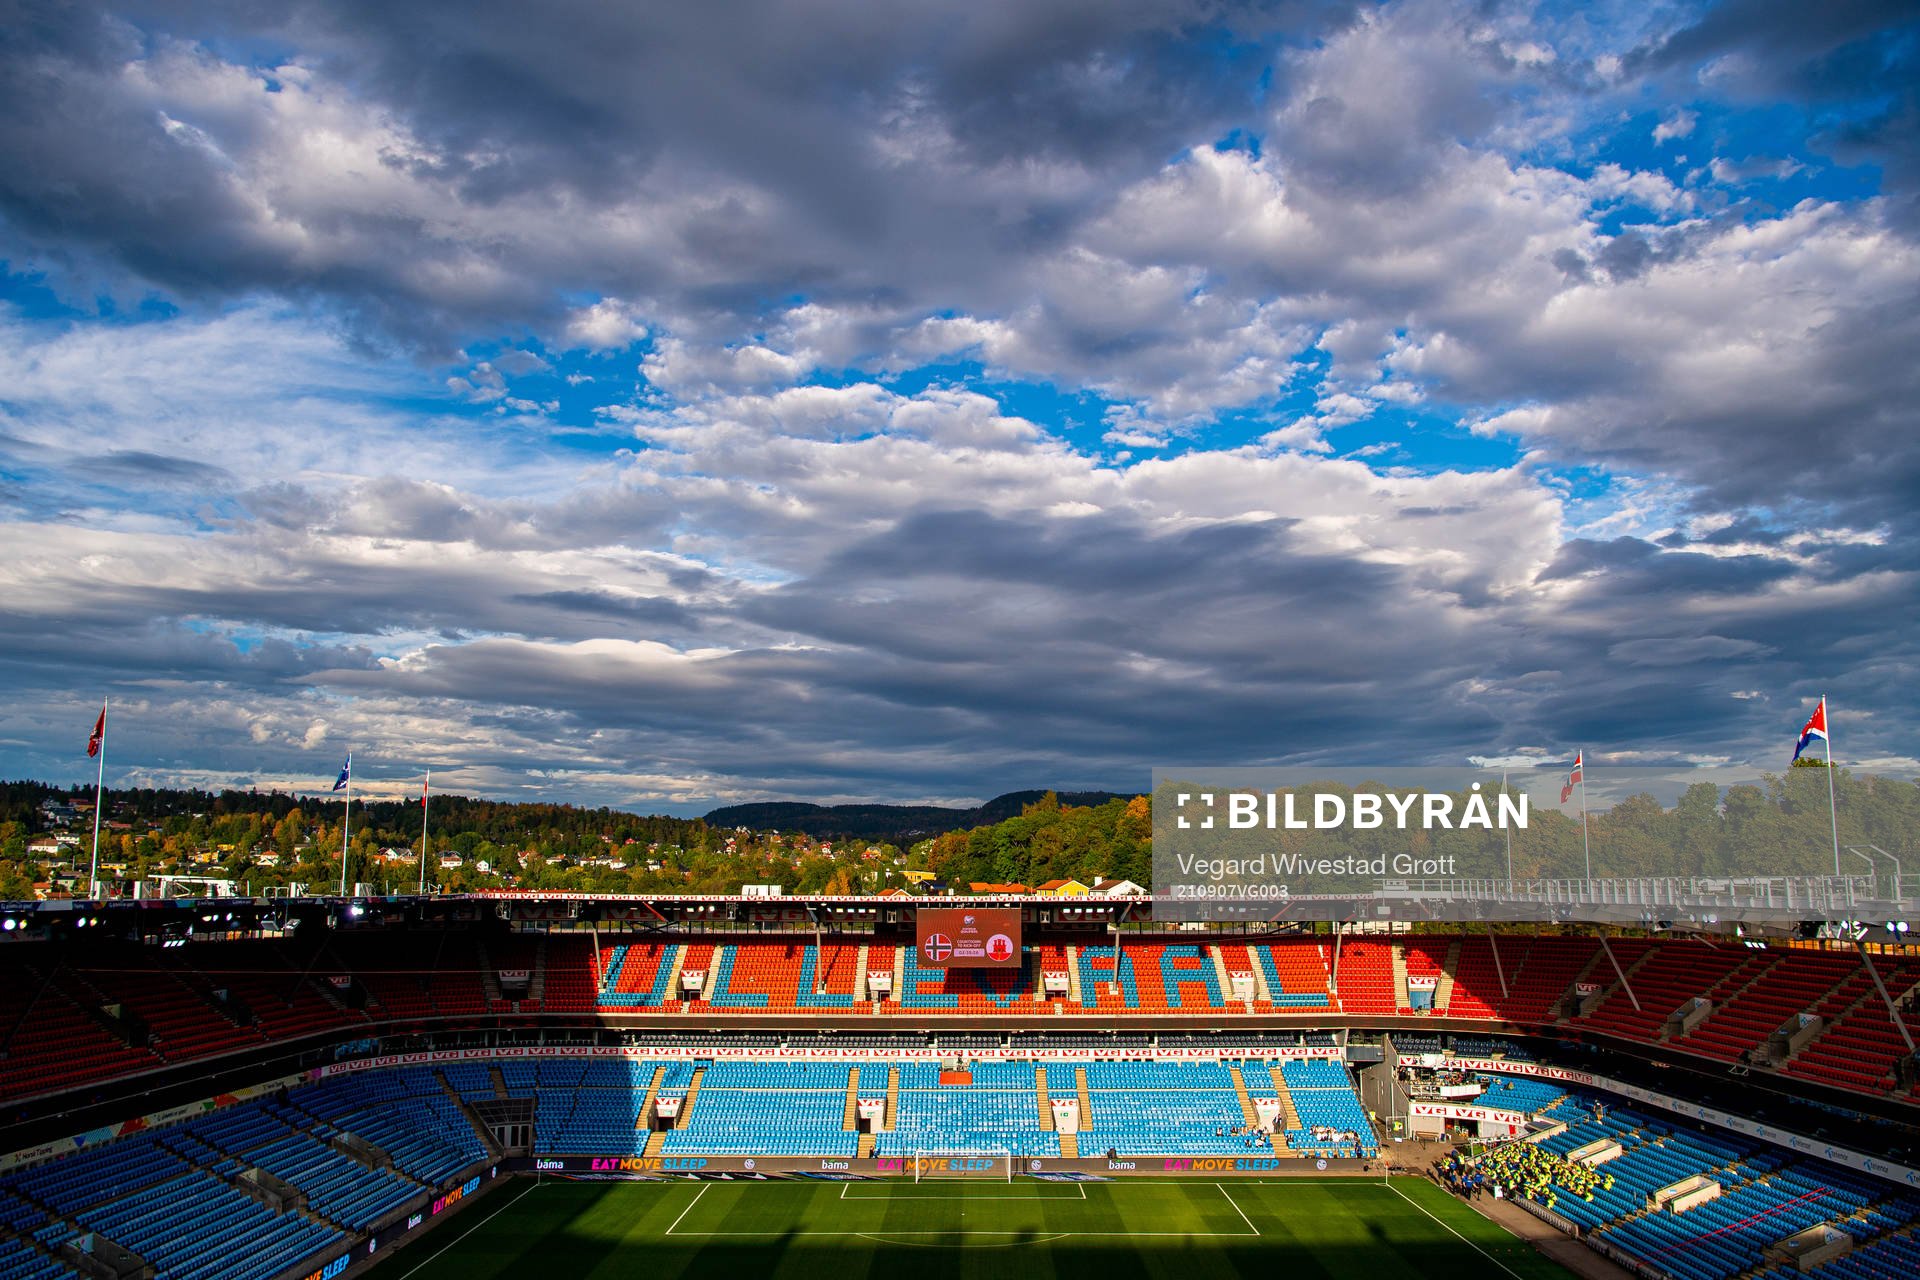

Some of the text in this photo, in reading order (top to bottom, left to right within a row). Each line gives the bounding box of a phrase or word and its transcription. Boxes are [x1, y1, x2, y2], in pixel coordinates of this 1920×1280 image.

[350, 1060, 372, 1070] VG
[376, 1056, 398, 1067] VG
[402, 1054, 428, 1063] VG
[432, 1051, 459, 1060] VG
[464, 1050, 490, 1058] VG
[1465, 1060, 1493, 1070] VG
[1496, 1062, 1523, 1072] VG
[1525, 1064, 1550, 1076] VG
[1551, 1069, 1574, 1080] VG
[1416, 1106, 1520, 1124] VG VG VG
[537, 1159, 564, 1170] bama
[592, 1158, 708, 1170] EAT MOVE SLEEP
[822, 1160, 849, 1170] bama
[878, 1159, 994, 1170] EAT MOVE SLEEP
[1108, 1160, 1136, 1170] bama
[1164, 1159, 1280, 1170] EAT MOVE SLEEP
[432, 1176, 480, 1216] EAT MOVE SLEEP
[322, 1253, 350, 1280] SLEEP
